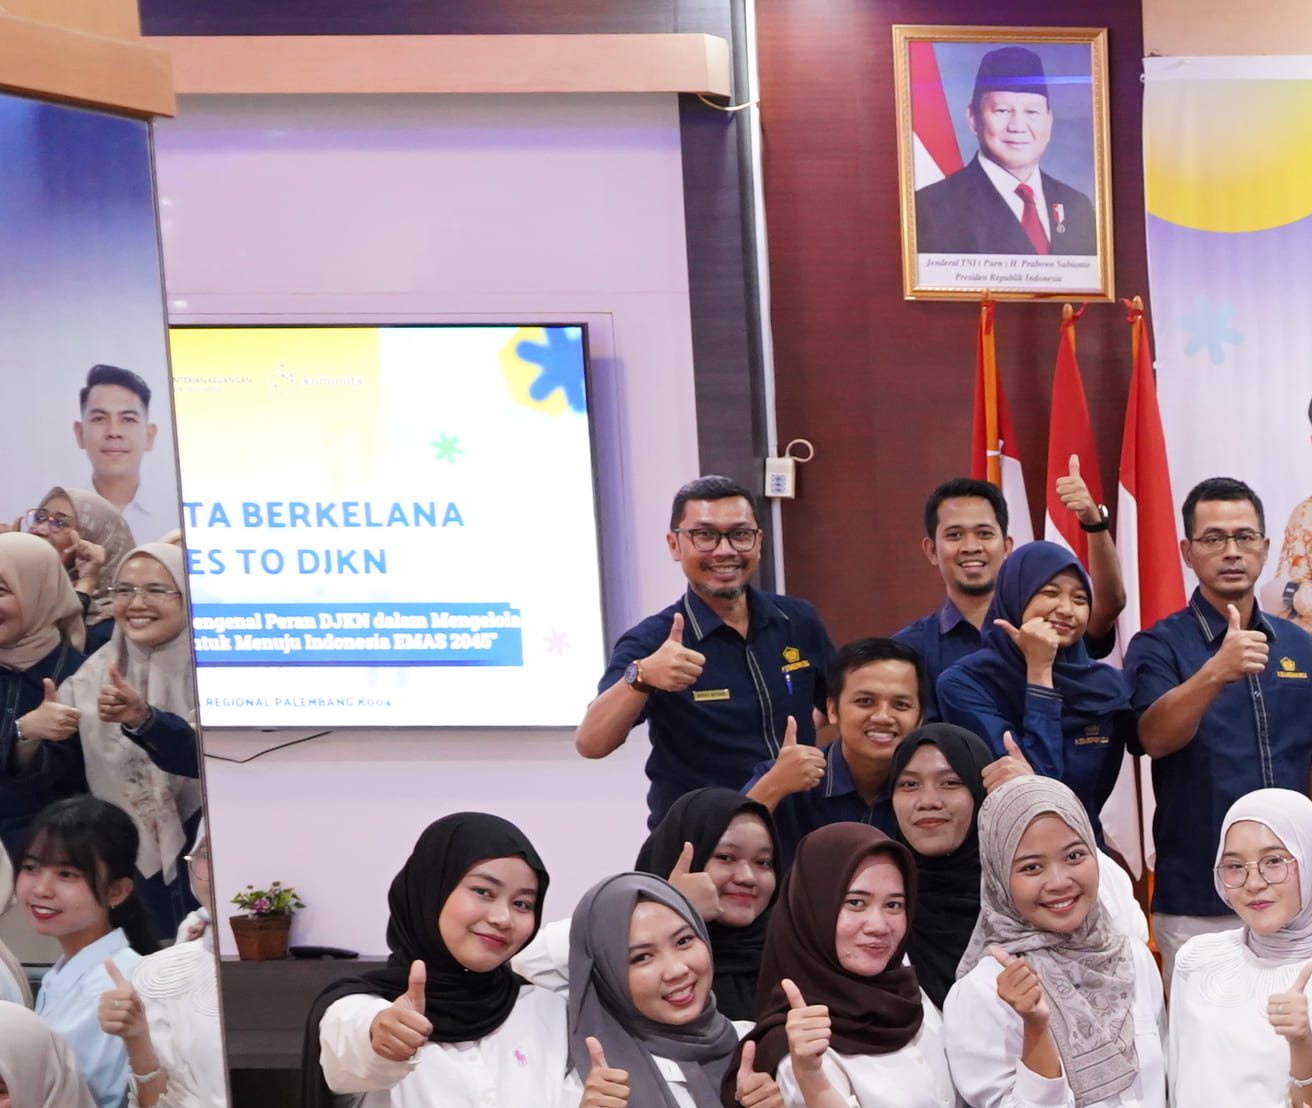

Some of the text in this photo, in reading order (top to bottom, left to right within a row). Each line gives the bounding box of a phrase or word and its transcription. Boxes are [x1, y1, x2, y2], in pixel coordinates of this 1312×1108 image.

[303, 375, 363, 387] komunita
[243, 502, 465, 528] BERKELANA
[236, 549, 285, 575] TO
[297, 548, 387, 575] DJKN
[264, 612, 317, 630] Peran
[318, 612, 371, 630] DJKN
[373, 611, 429, 629] dalam
[430, 610, 522, 632] Mengelola
[234, 633, 302, 654] Menuju
[304, 633, 391, 651] Indonesia
[392, 632, 447, 650] EMAS
[206, 697, 269, 708] REGIONAL
[275, 697, 354, 708] PALEMBANG
